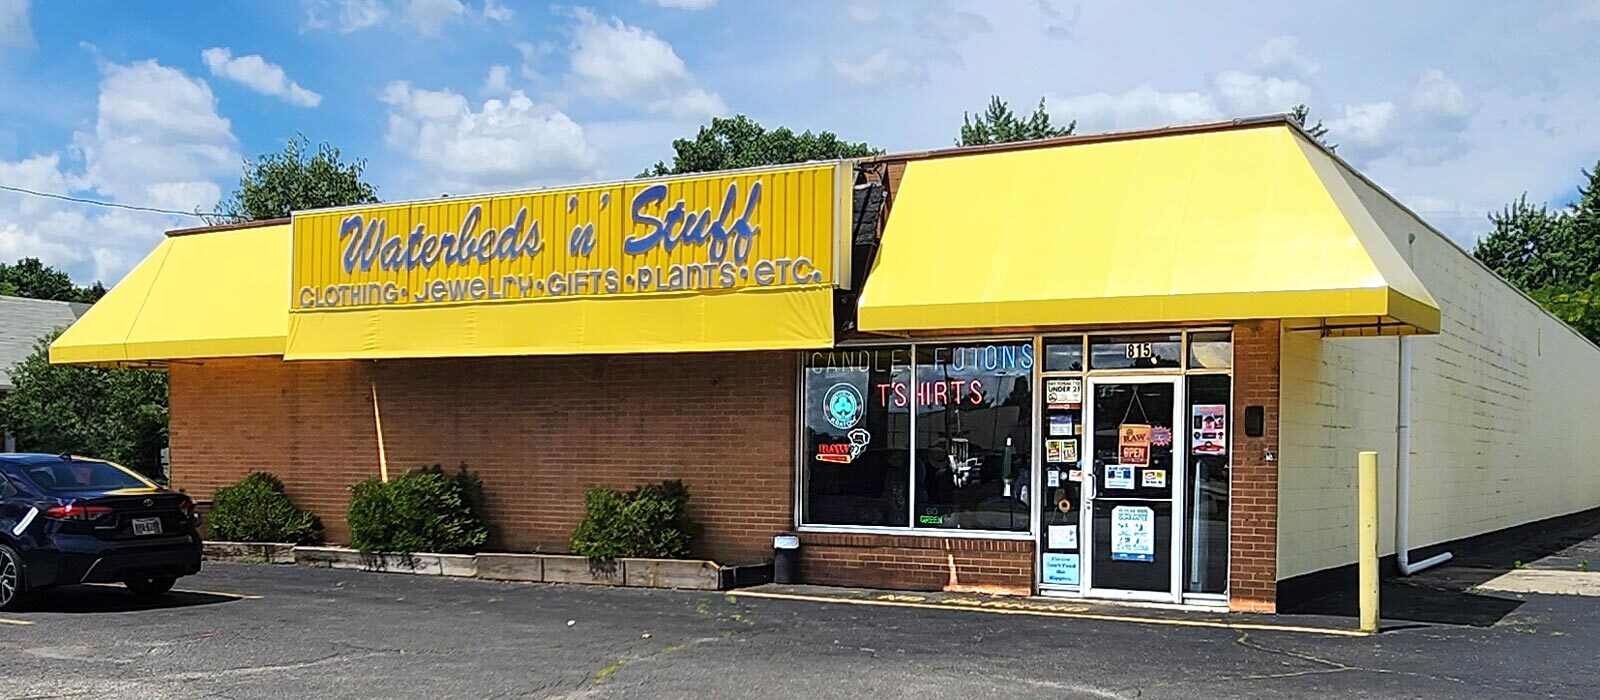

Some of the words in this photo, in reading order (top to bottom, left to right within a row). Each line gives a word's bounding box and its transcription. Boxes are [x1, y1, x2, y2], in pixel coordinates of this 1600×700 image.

[339, 204, 545, 274] Waterbeds
[567, 191, 611, 257] 'n'
[623, 180, 762, 264] Stuff
[546, 268, 620, 297] GIFTS
[1128, 343, 1150, 358] 815
[1123, 433, 1146, 443] RAW
[819, 443, 850, 455] RAW
[1123, 447, 1146, 458] OPEN
